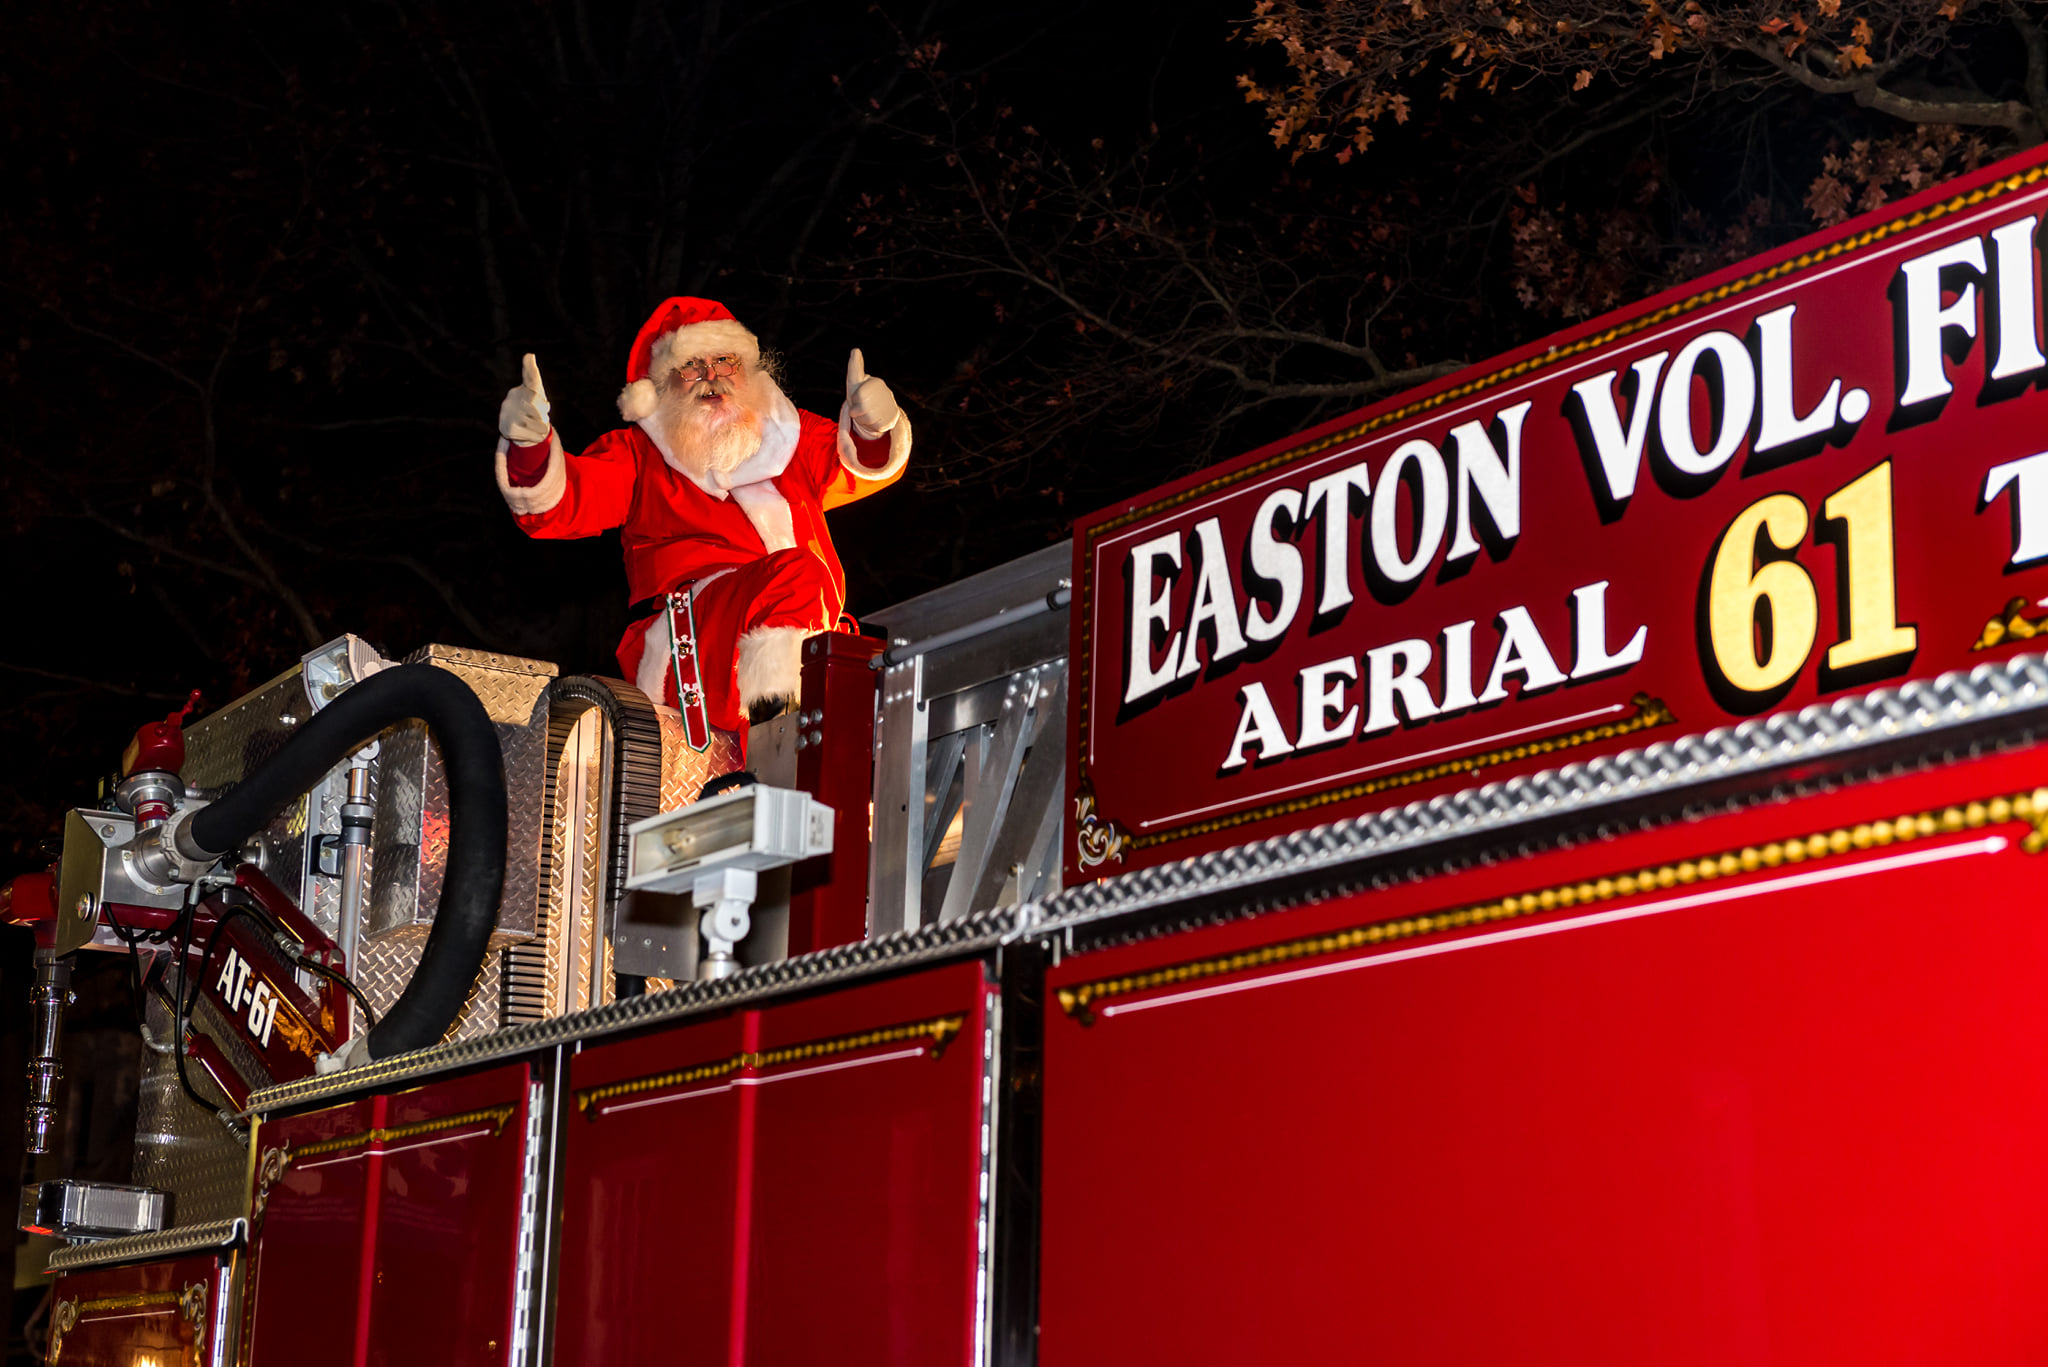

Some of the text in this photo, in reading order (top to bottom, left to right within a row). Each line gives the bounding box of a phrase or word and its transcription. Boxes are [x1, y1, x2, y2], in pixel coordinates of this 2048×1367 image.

[1123, 400, 1532, 705] EASTON
[1571, 303, 1871, 500] VOL.
[1220, 580, 1649, 770] AERIAL
[1708, 460, 1918, 692] 61
[215, 946, 279, 1049] AT-61
